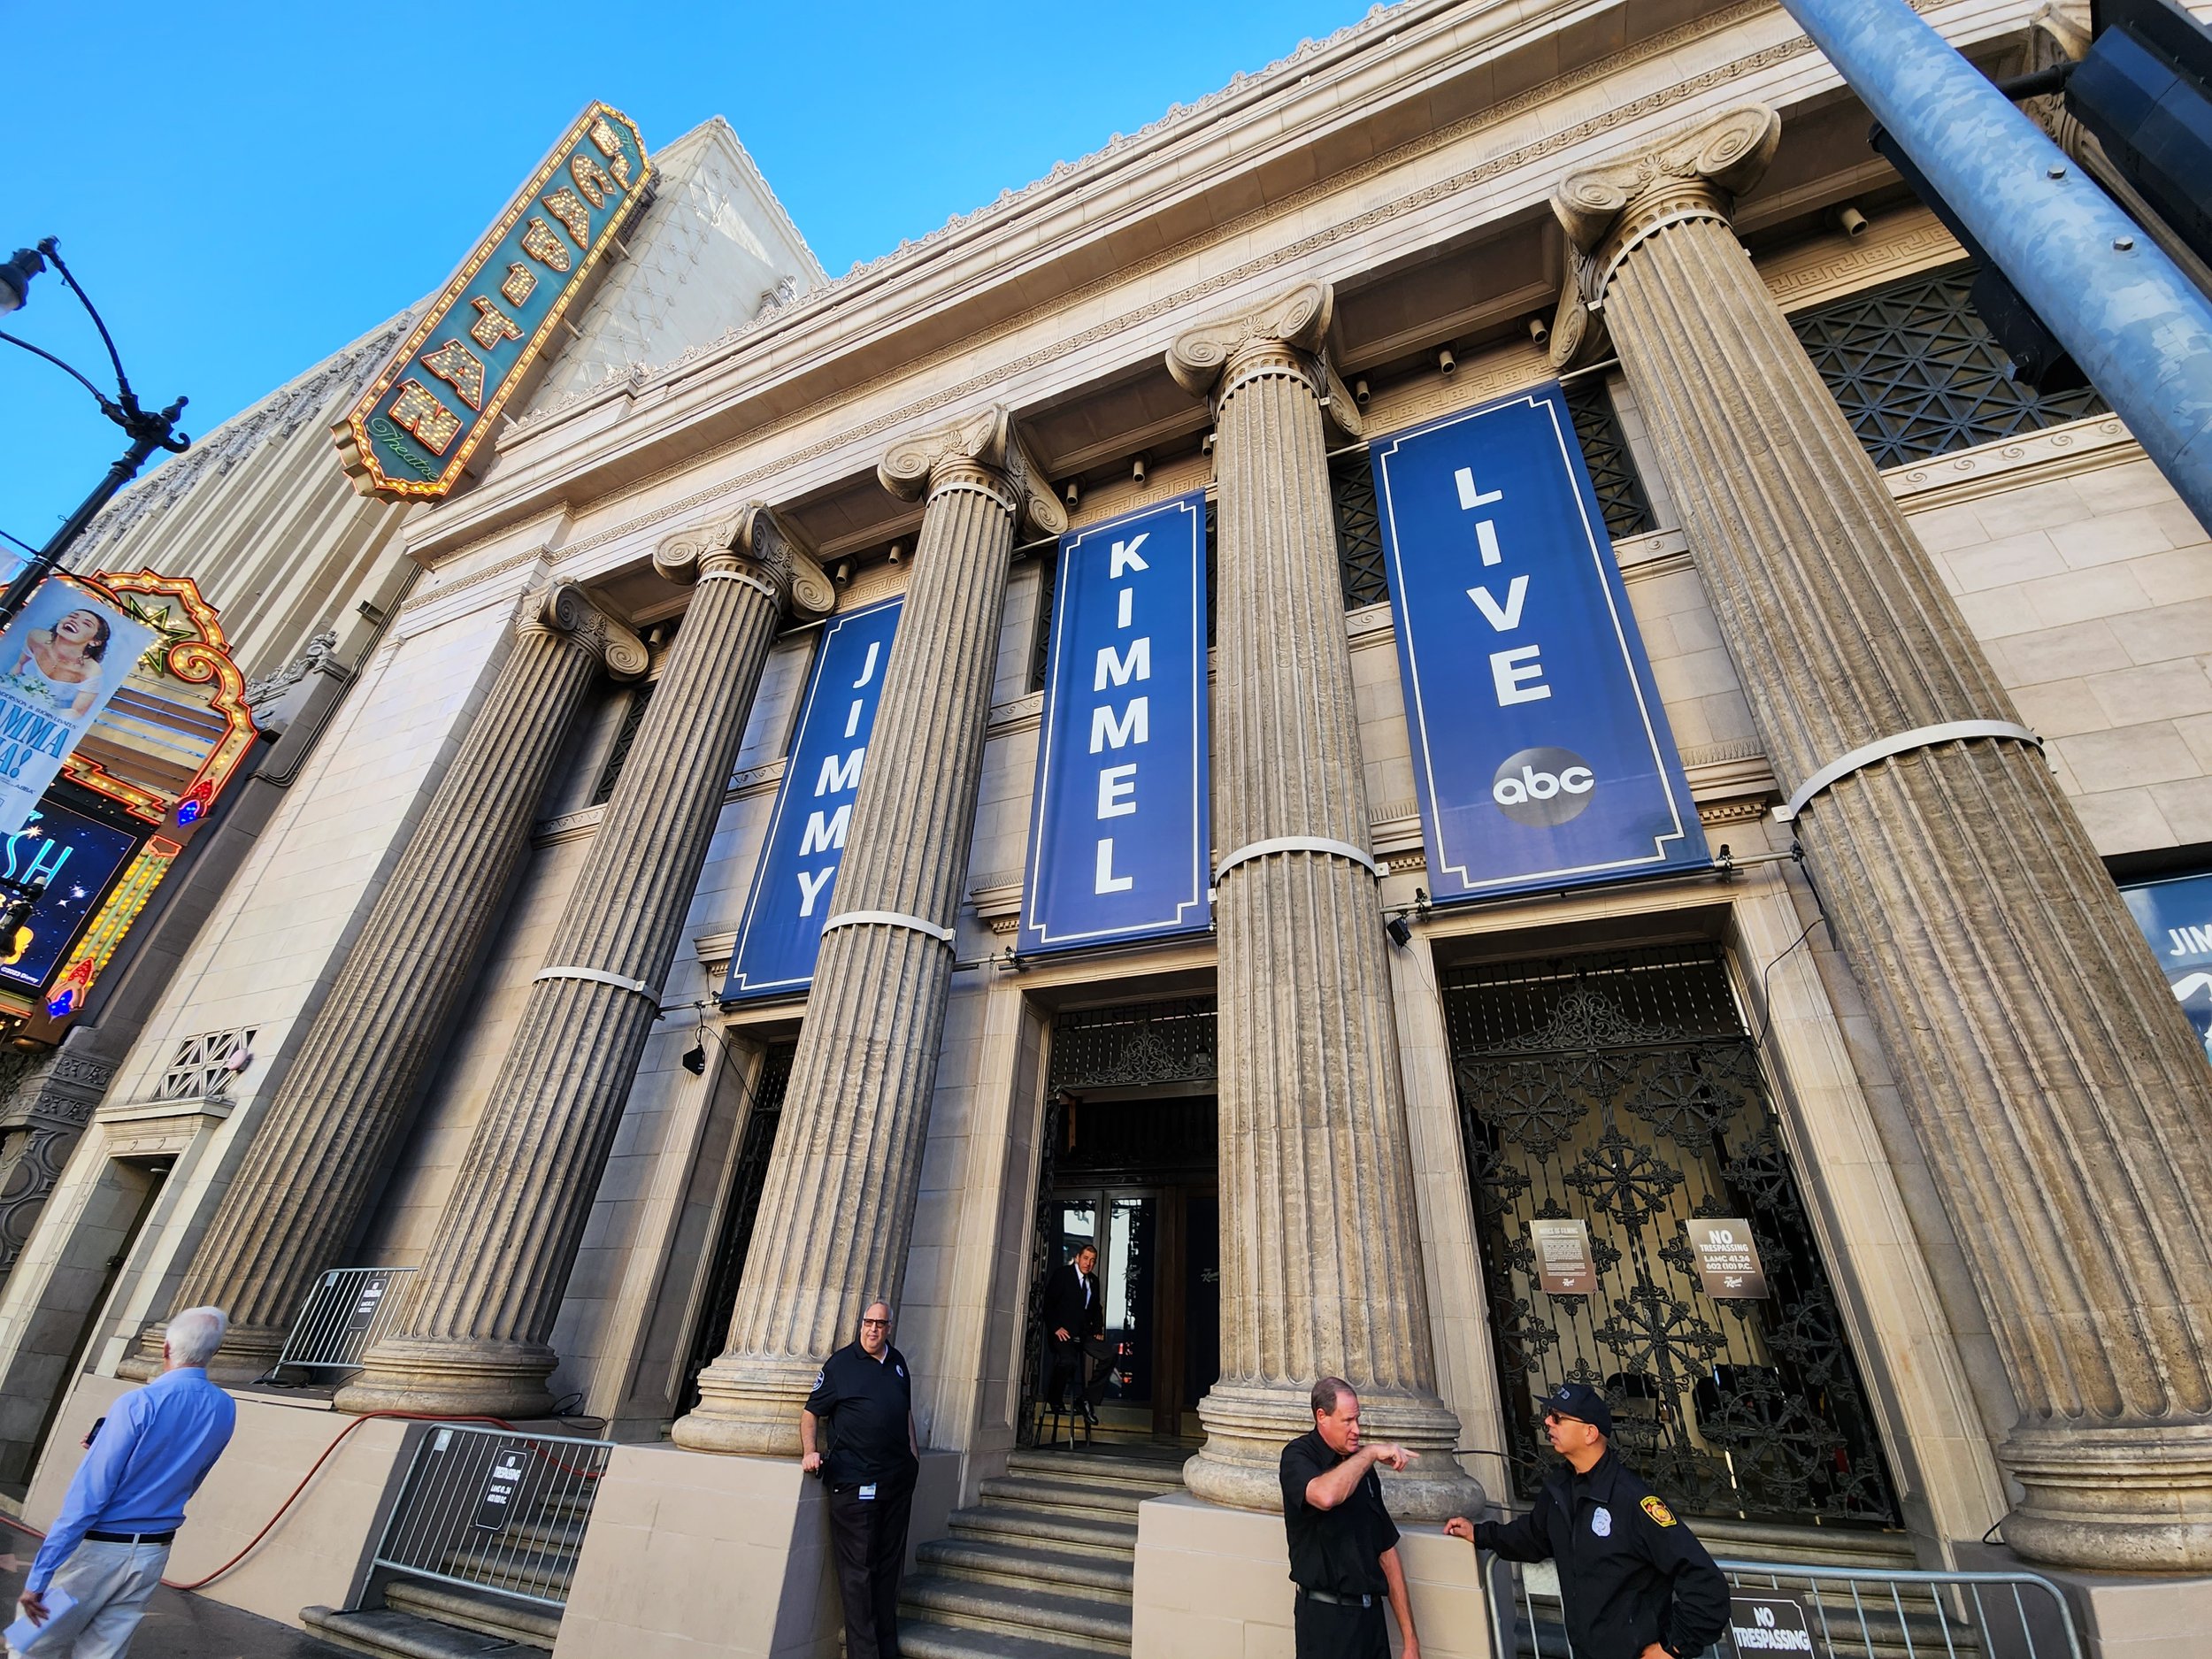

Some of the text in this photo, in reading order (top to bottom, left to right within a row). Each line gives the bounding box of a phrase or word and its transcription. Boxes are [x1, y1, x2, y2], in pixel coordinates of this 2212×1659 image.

[590, 117, 633, 191] EL
[388, 154, 617, 457] CAPITAN
[365, 418, 439, 482] Theatre
[1453, 466, 1552, 707] LIVE
[1088, 533, 1151, 895] KIMMEL
[796, 641, 880, 918] JIMMY
[1493, 764, 1594, 804] abc
[0, 829, 73, 890] SH
[1709, 1230, 1733, 1244] NO
[1733, 1627, 1811, 1651] TRESPASSING
[1753, 1606, 1775, 1628] NO
